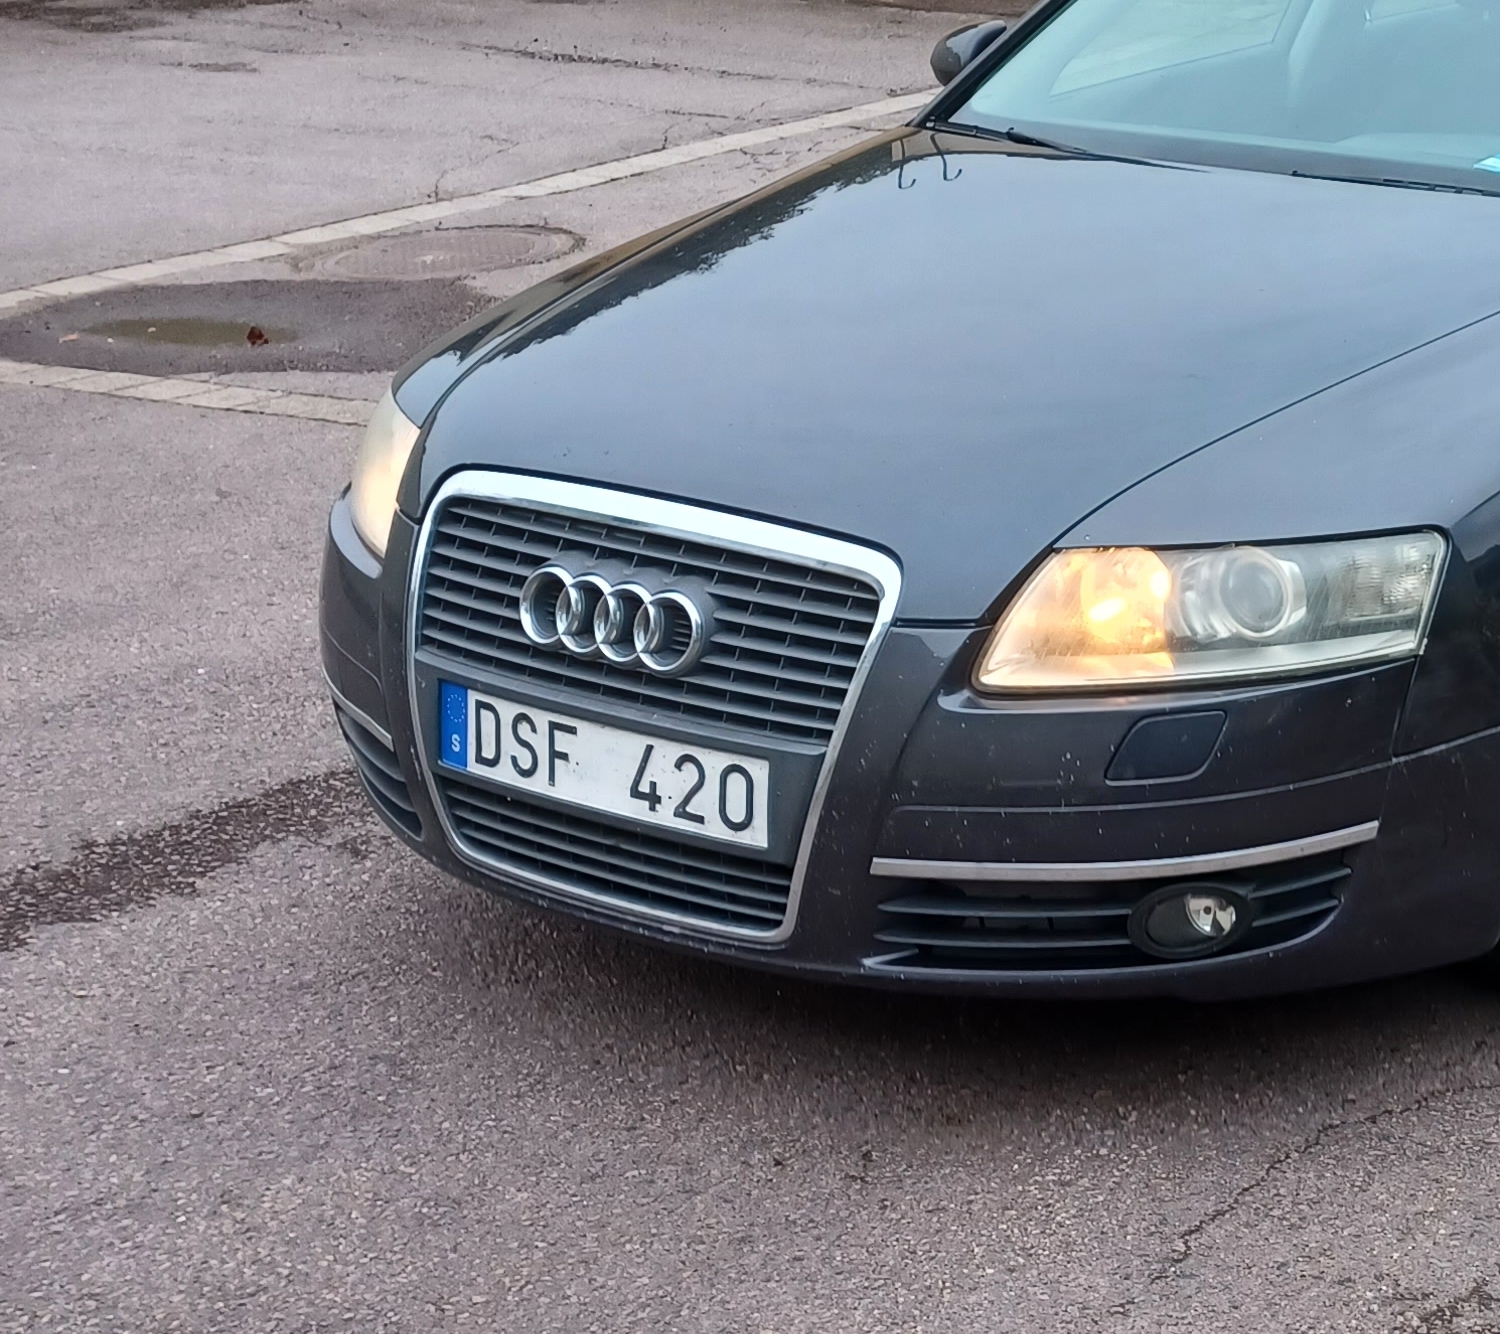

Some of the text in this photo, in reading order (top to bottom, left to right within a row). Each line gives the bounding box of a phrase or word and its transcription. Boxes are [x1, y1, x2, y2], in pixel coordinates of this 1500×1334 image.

[451, 733, 461, 754] S
[473, 698, 755, 832] DSF 420
